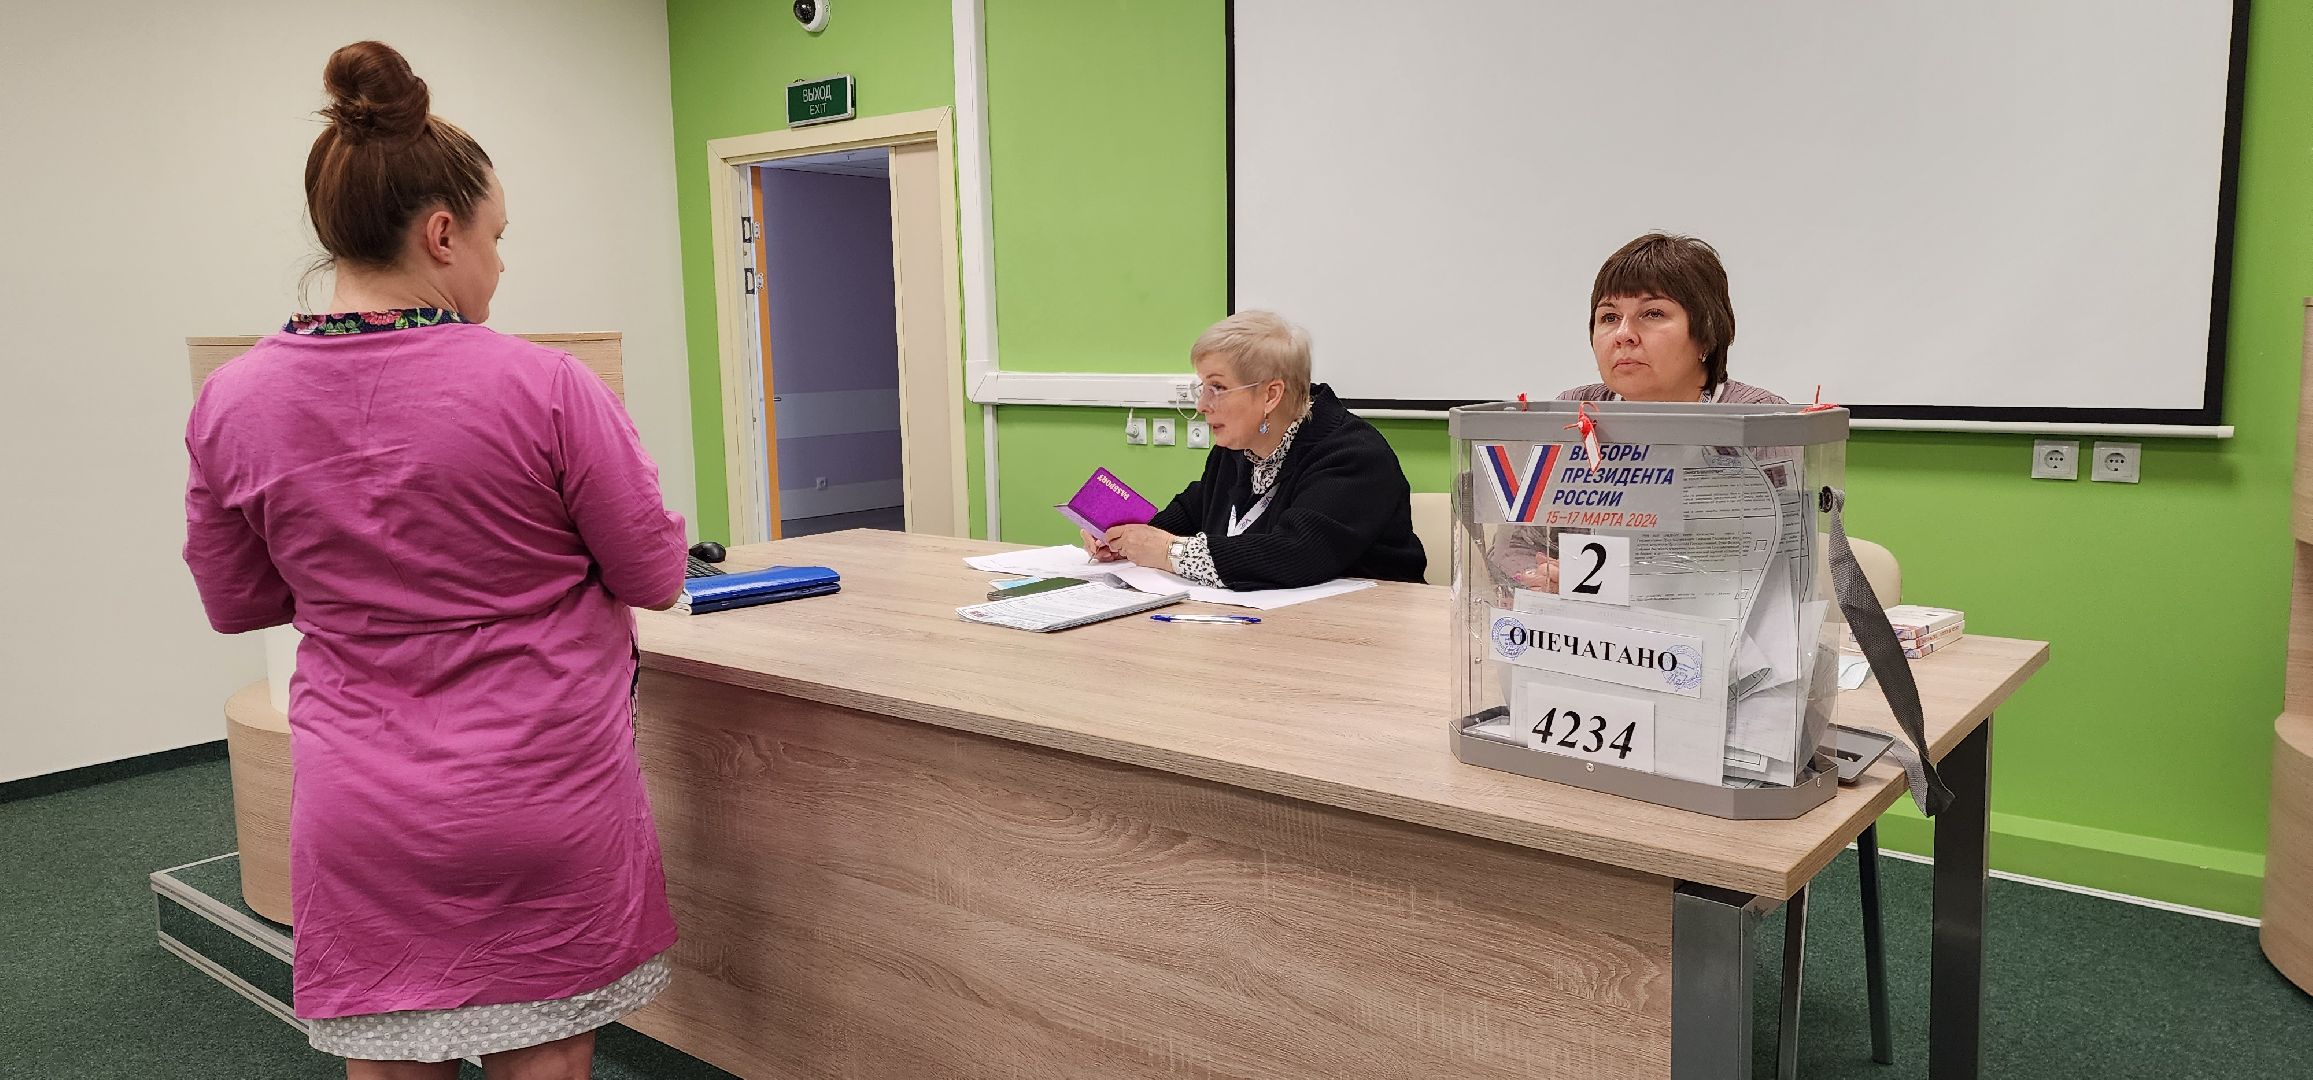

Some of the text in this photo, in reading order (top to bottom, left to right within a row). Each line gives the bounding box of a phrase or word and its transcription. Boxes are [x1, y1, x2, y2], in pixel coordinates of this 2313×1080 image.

[802, 84, 832, 102] ВЫХОД
[809, 103, 827, 115] EXIT
[1560, 467, 1675, 487] ПРЕЗИДЕНТА
[1552, 489, 1624, 507] РОССИИ
[1581, 511, 1624, 527] МАРТА
[1625, 513, 1659, 528] 2024
[1571, 542, 1608, 595] 2
[1509, 626, 1678, 672] ОПЕЧАТАНО
[1531, 707, 1637, 759] 4234
